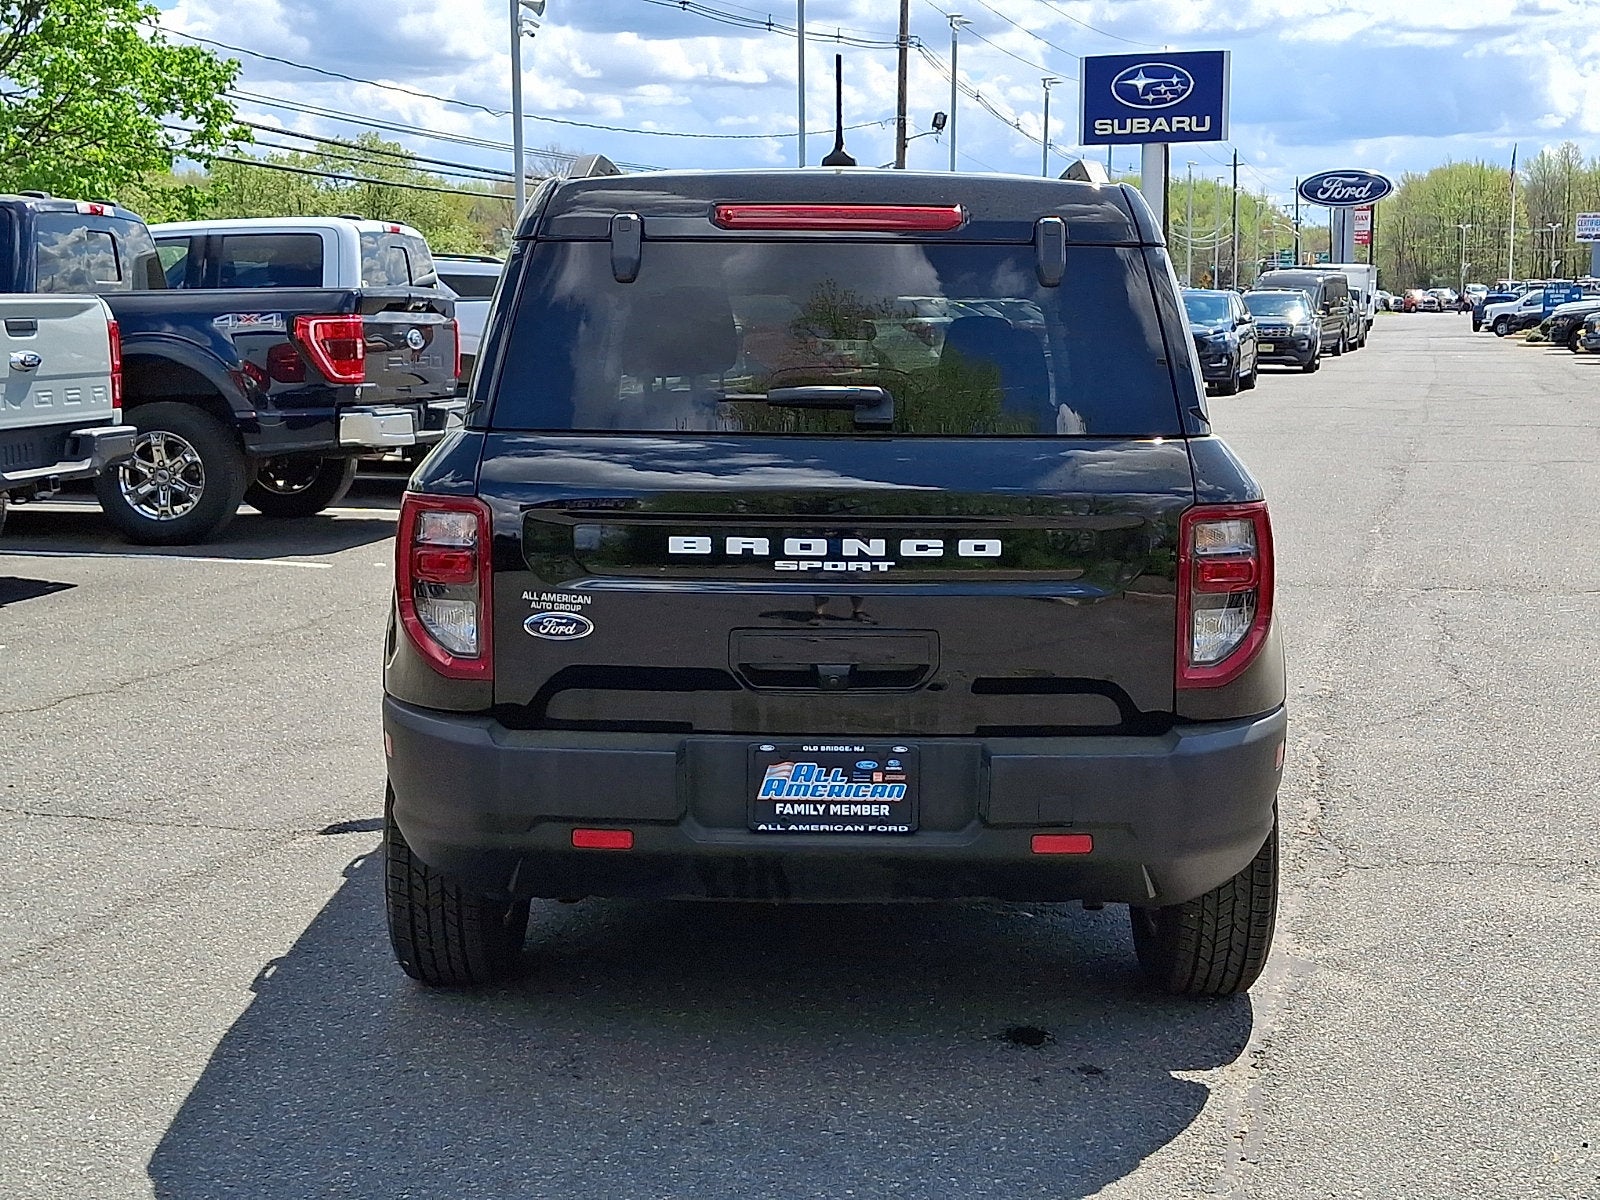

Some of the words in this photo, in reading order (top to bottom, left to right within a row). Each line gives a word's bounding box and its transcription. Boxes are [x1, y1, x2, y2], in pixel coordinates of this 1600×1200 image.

[1094, 115, 1211, 135] SUBARU
[1317, 176, 1373, 200] Ford
[668, 536, 1002, 557] BRONCO
[774, 561, 896, 572] SPORT
[522, 590, 540, 600] ALL
[541, 592, 592, 604] AMERICAN
[530, 601, 552, 610] AUTO
[553, 603, 582, 611] GROUP
[539, 617, 578, 635] Ford
[790, 762, 848, 783] ALL
[760, 777, 907, 800] AMERICAN
[775, 803, 826, 815] FAMILY
[829, 804, 890, 816] MEMBER
[788, 824, 864, 832] AMERICAN
